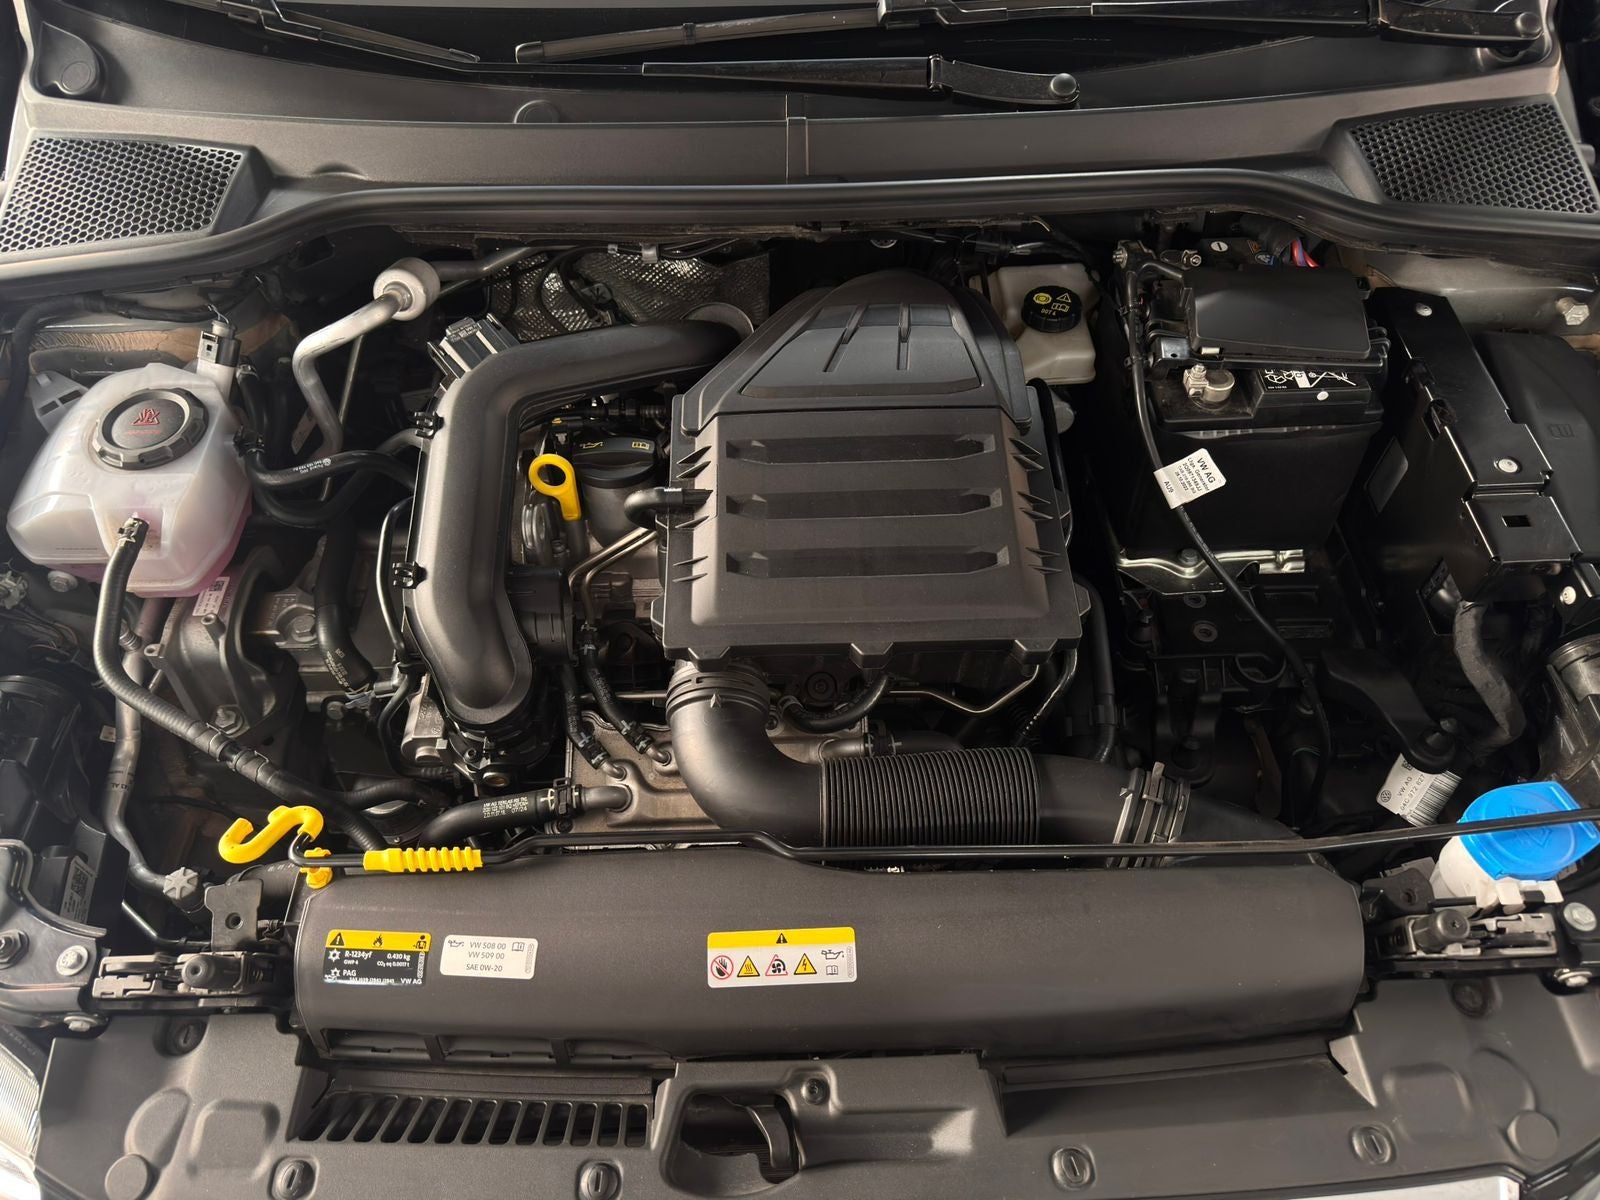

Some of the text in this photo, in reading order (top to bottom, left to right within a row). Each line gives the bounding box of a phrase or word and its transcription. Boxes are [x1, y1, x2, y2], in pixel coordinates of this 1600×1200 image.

[1197, 457, 1216, 484] VW AG
[344, 951, 372, 960] R-1234yf
